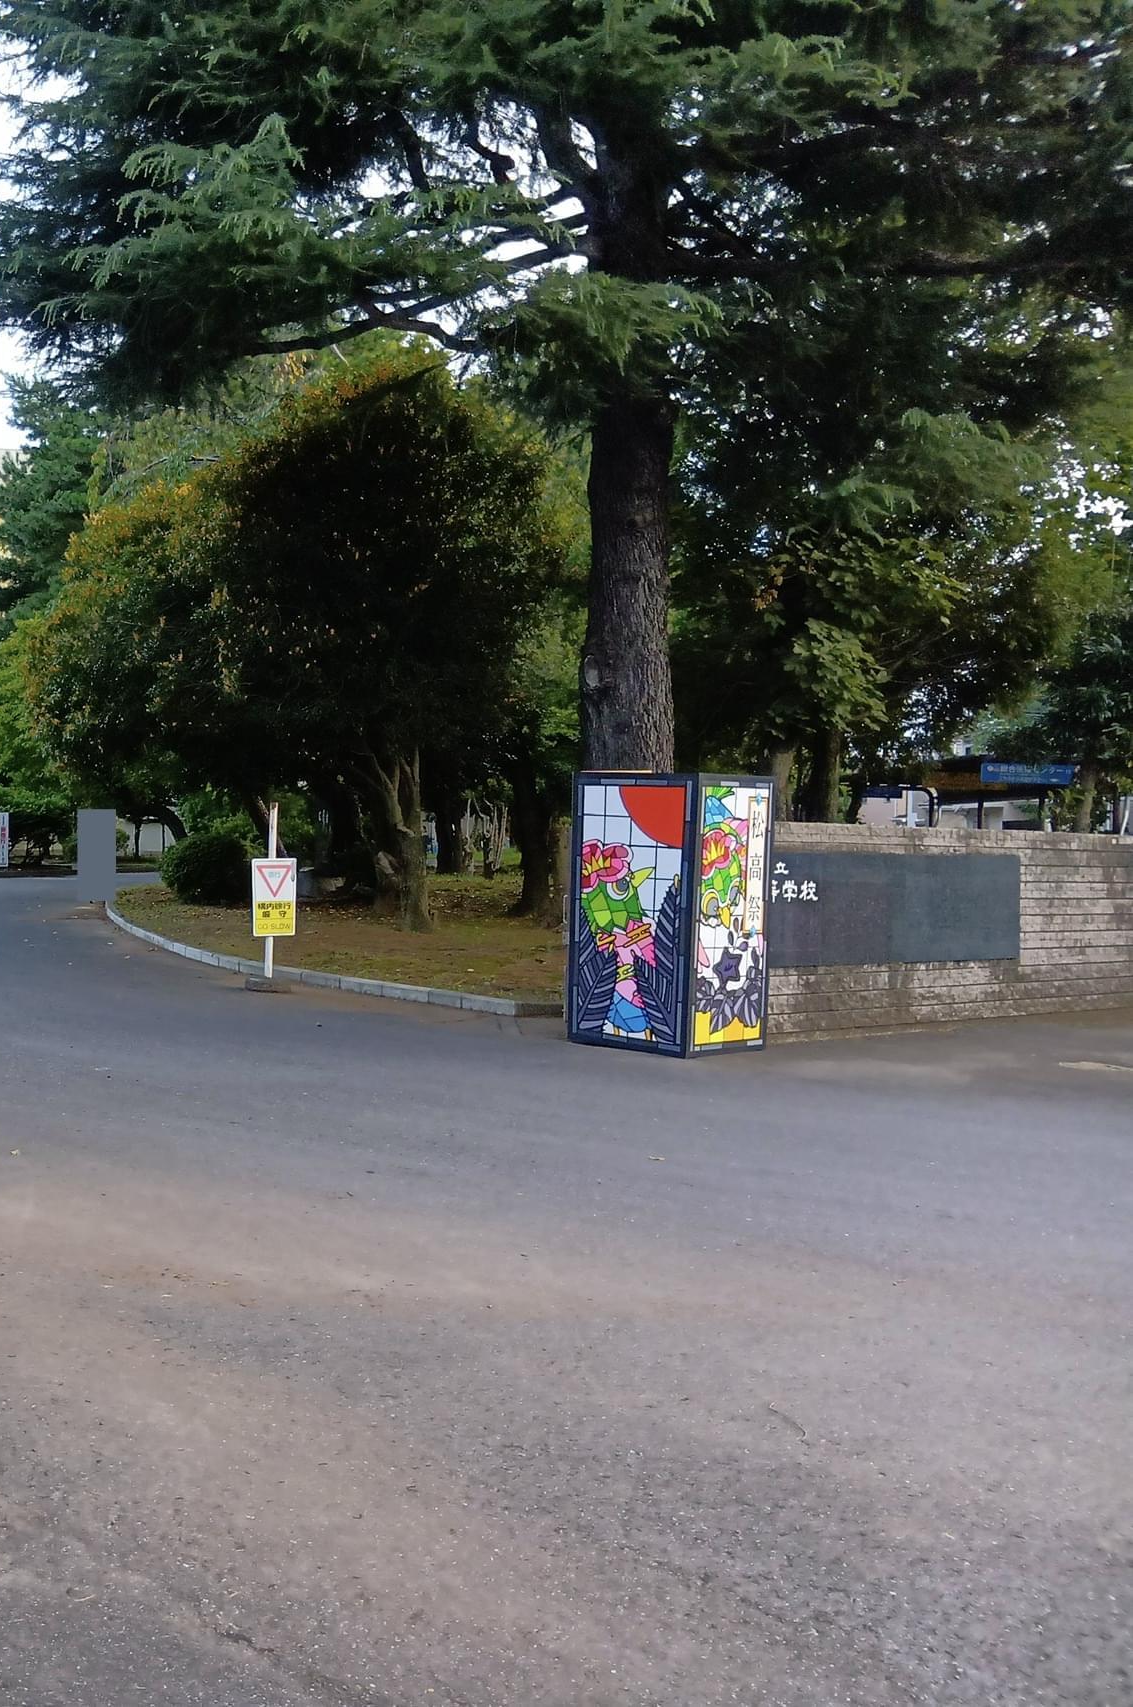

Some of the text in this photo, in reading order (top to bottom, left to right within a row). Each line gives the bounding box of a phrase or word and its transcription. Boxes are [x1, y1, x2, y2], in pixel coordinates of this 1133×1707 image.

[748, 810, 765, 921] 松高祭
[773, 861, 789, 875] 立
